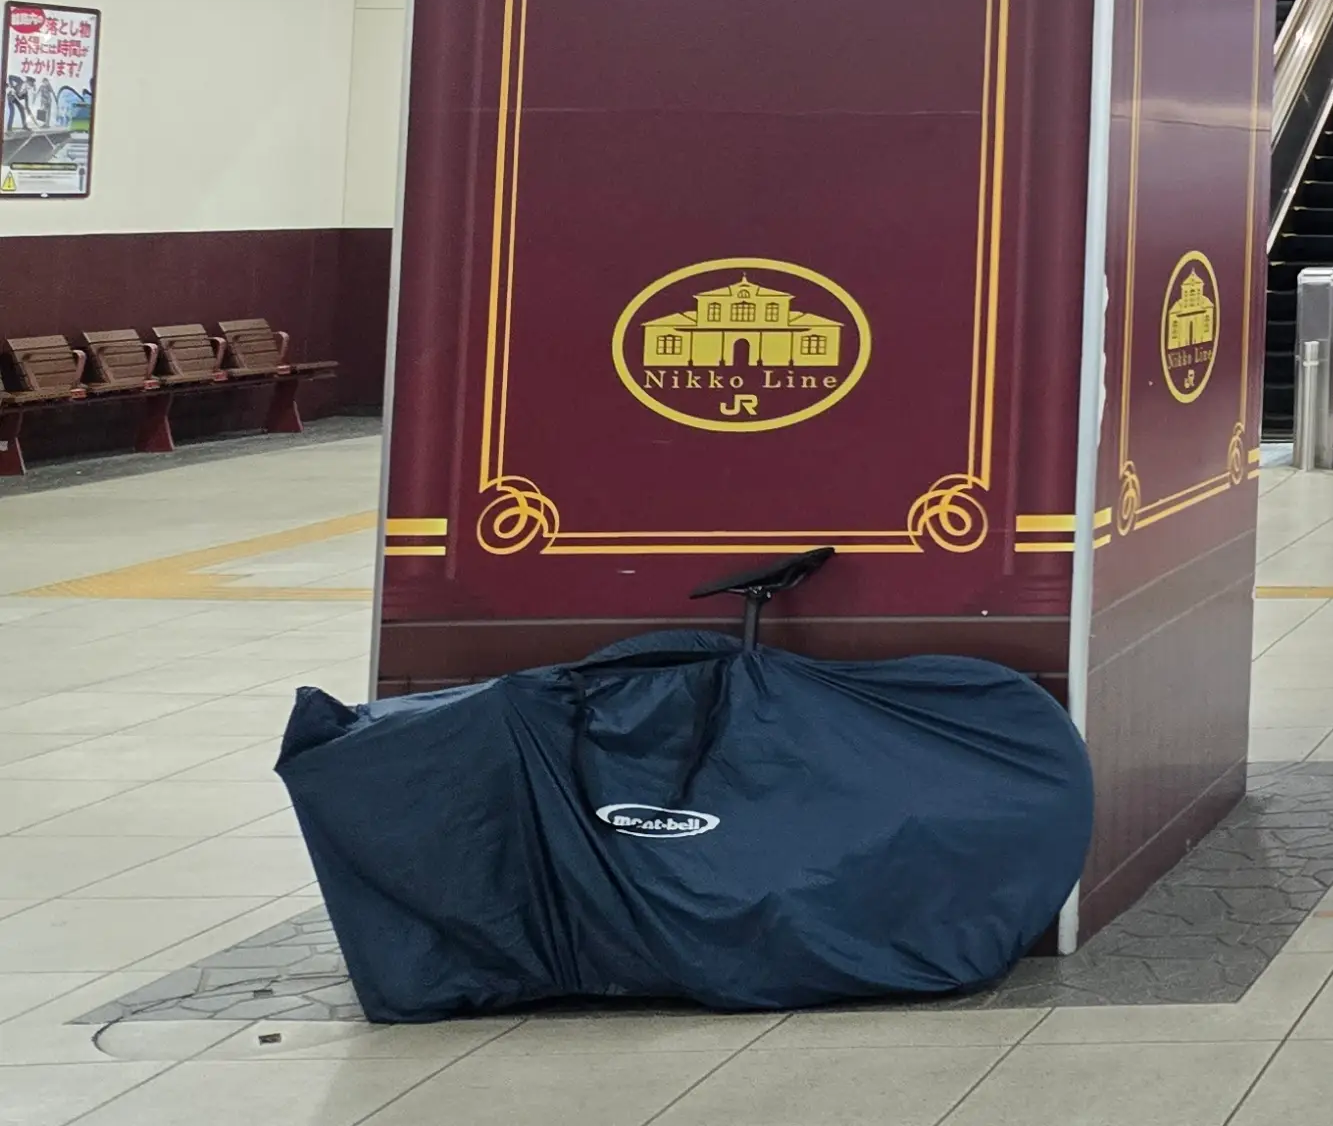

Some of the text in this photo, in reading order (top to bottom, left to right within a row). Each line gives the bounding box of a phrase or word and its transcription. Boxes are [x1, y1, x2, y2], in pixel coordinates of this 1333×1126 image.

[643, 369, 838, 389] Nikko Line
[719, 394, 758, 416] JR
